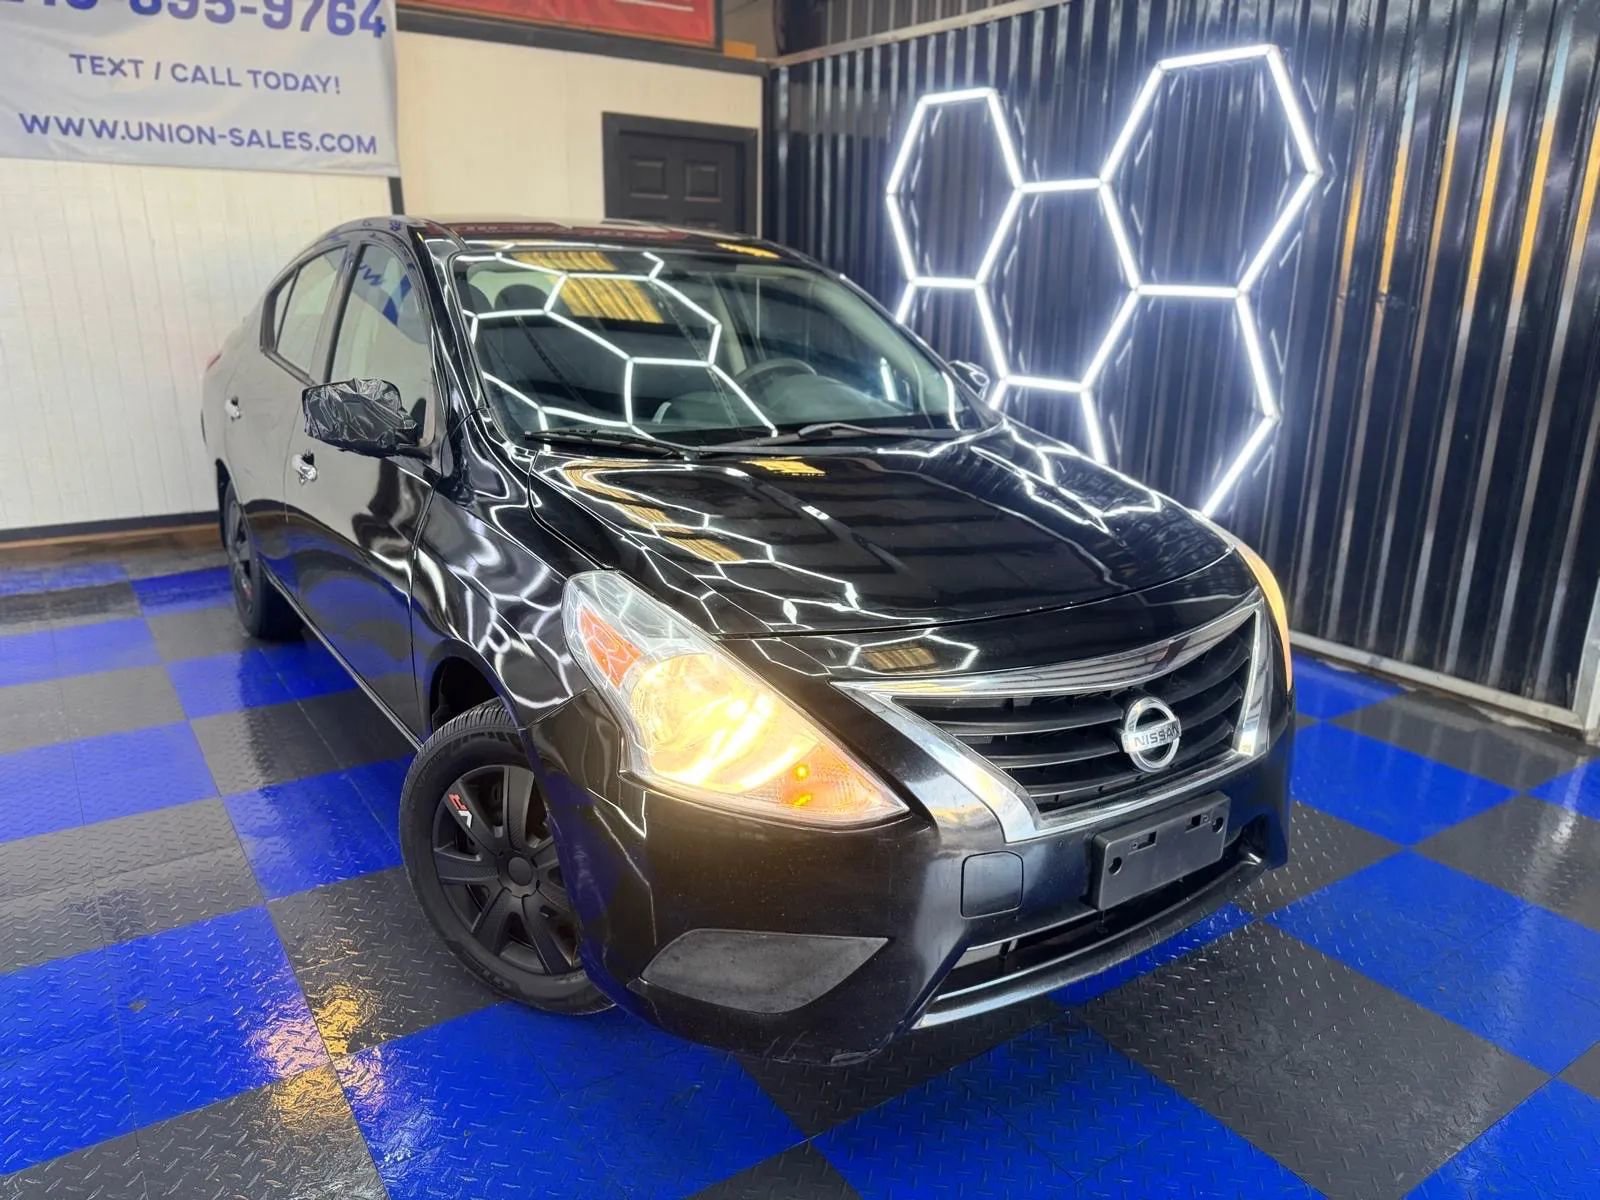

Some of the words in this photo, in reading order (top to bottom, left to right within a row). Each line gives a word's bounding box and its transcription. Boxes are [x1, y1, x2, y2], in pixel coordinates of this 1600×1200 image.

[69, 54, 144, 79] TEXT
[171, 64, 241, 87] CALL
[247, 69, 340, 94] TODAY!
[19, 113, 377, 154] WWW.UNION-SALES.COM
[1133, 724, 1180, 747] NISSAN
